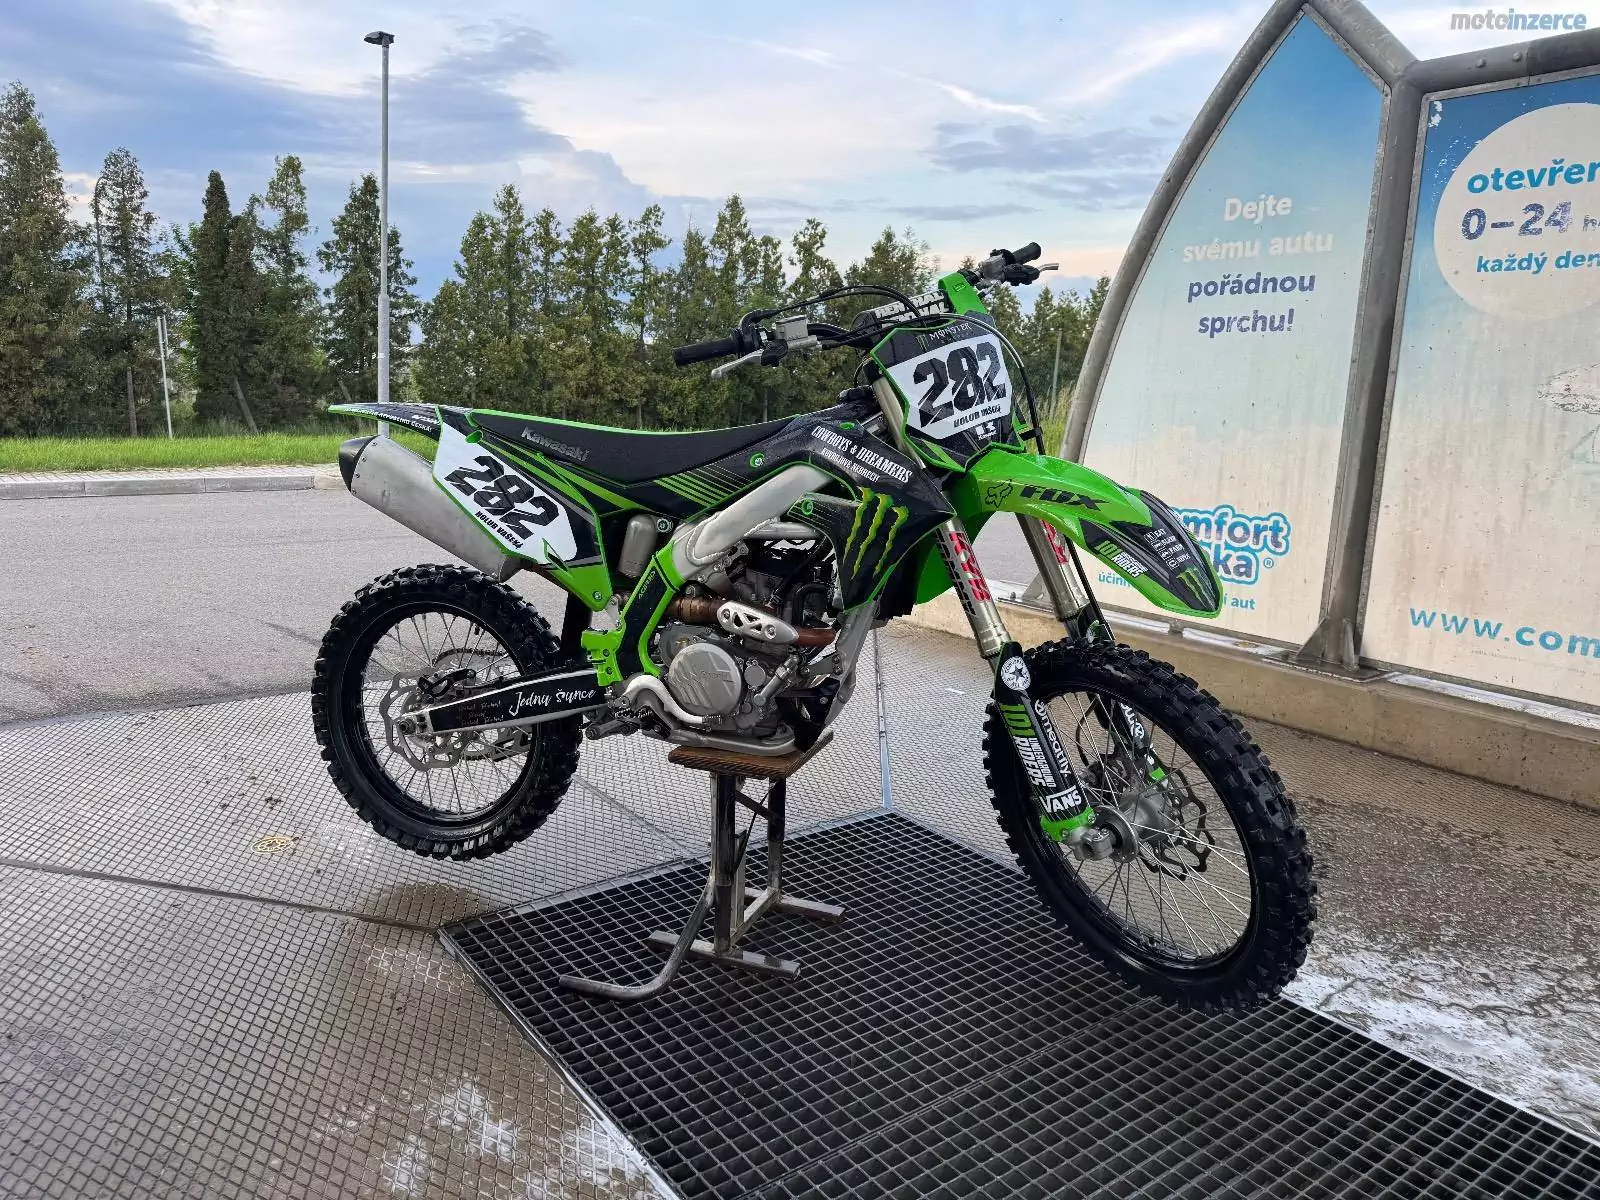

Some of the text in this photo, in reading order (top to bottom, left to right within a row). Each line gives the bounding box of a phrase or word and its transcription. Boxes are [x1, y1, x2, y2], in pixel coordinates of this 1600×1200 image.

[1223, 194, 1292, 225] Dejte
[1181, 231, 1333, 263] svému autu
[1476, 252, 1548, 275] každý
[1187, 272, 1316, 303] pořádnou
[1198, 308, 1295, 339] sprchu!
[912, 341, 1007, 428] 282
[520, 425, 593, 462] Kawasaki
[811, 425, 853, 452] COWBOYS
[855, 446, 913, 483] DREAMERS
[444, 455, 560, 541] 282
[1020, 484, 1110, 512] FOX
[1231, 597, 1256, 610] aut
[1012, 735, 1047, 787] RIDERS
[1039, 785, 1082, 814] VANS
